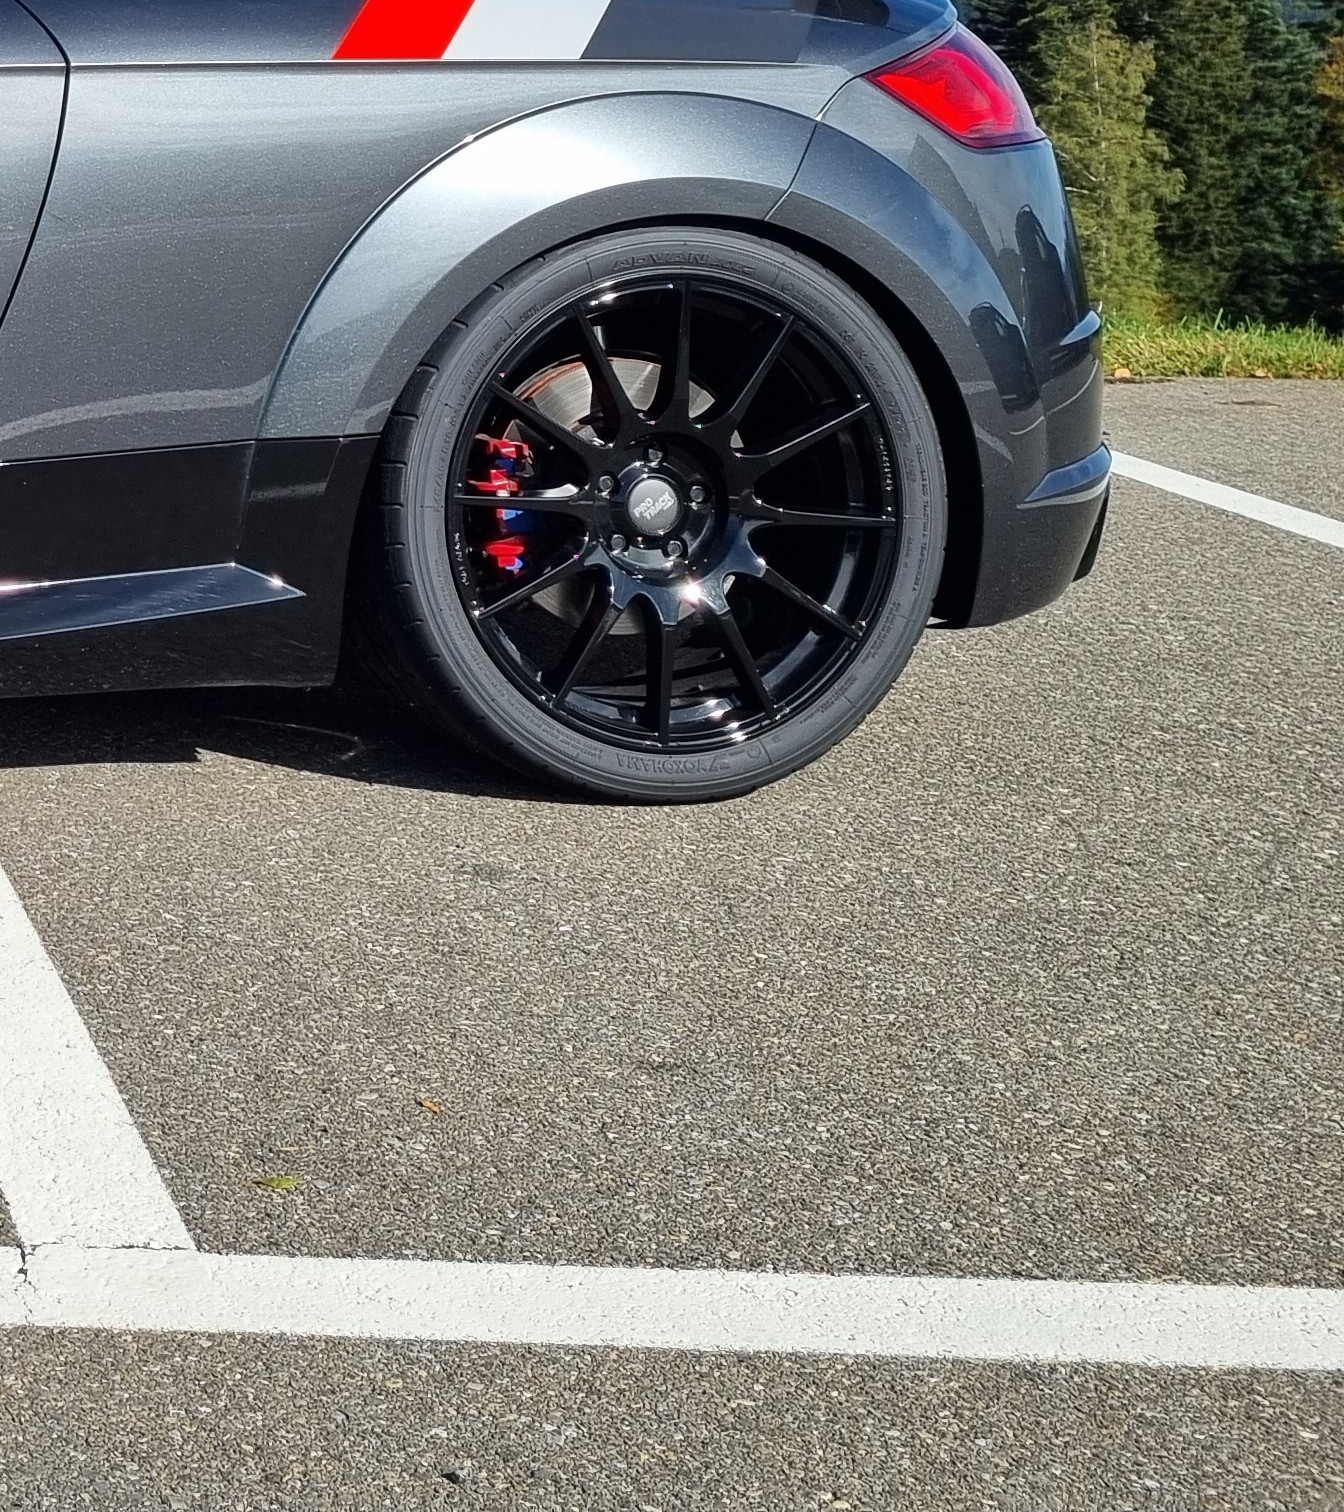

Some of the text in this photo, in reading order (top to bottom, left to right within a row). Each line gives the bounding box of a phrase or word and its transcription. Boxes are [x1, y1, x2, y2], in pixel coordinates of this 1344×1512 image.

[612, 251, 710, 271] ADVAN
[633, 497, 653, 518] PRO
[643, 491, 675, 520] TRACK
[614, 752, 706, 775] YOKOHAMA
